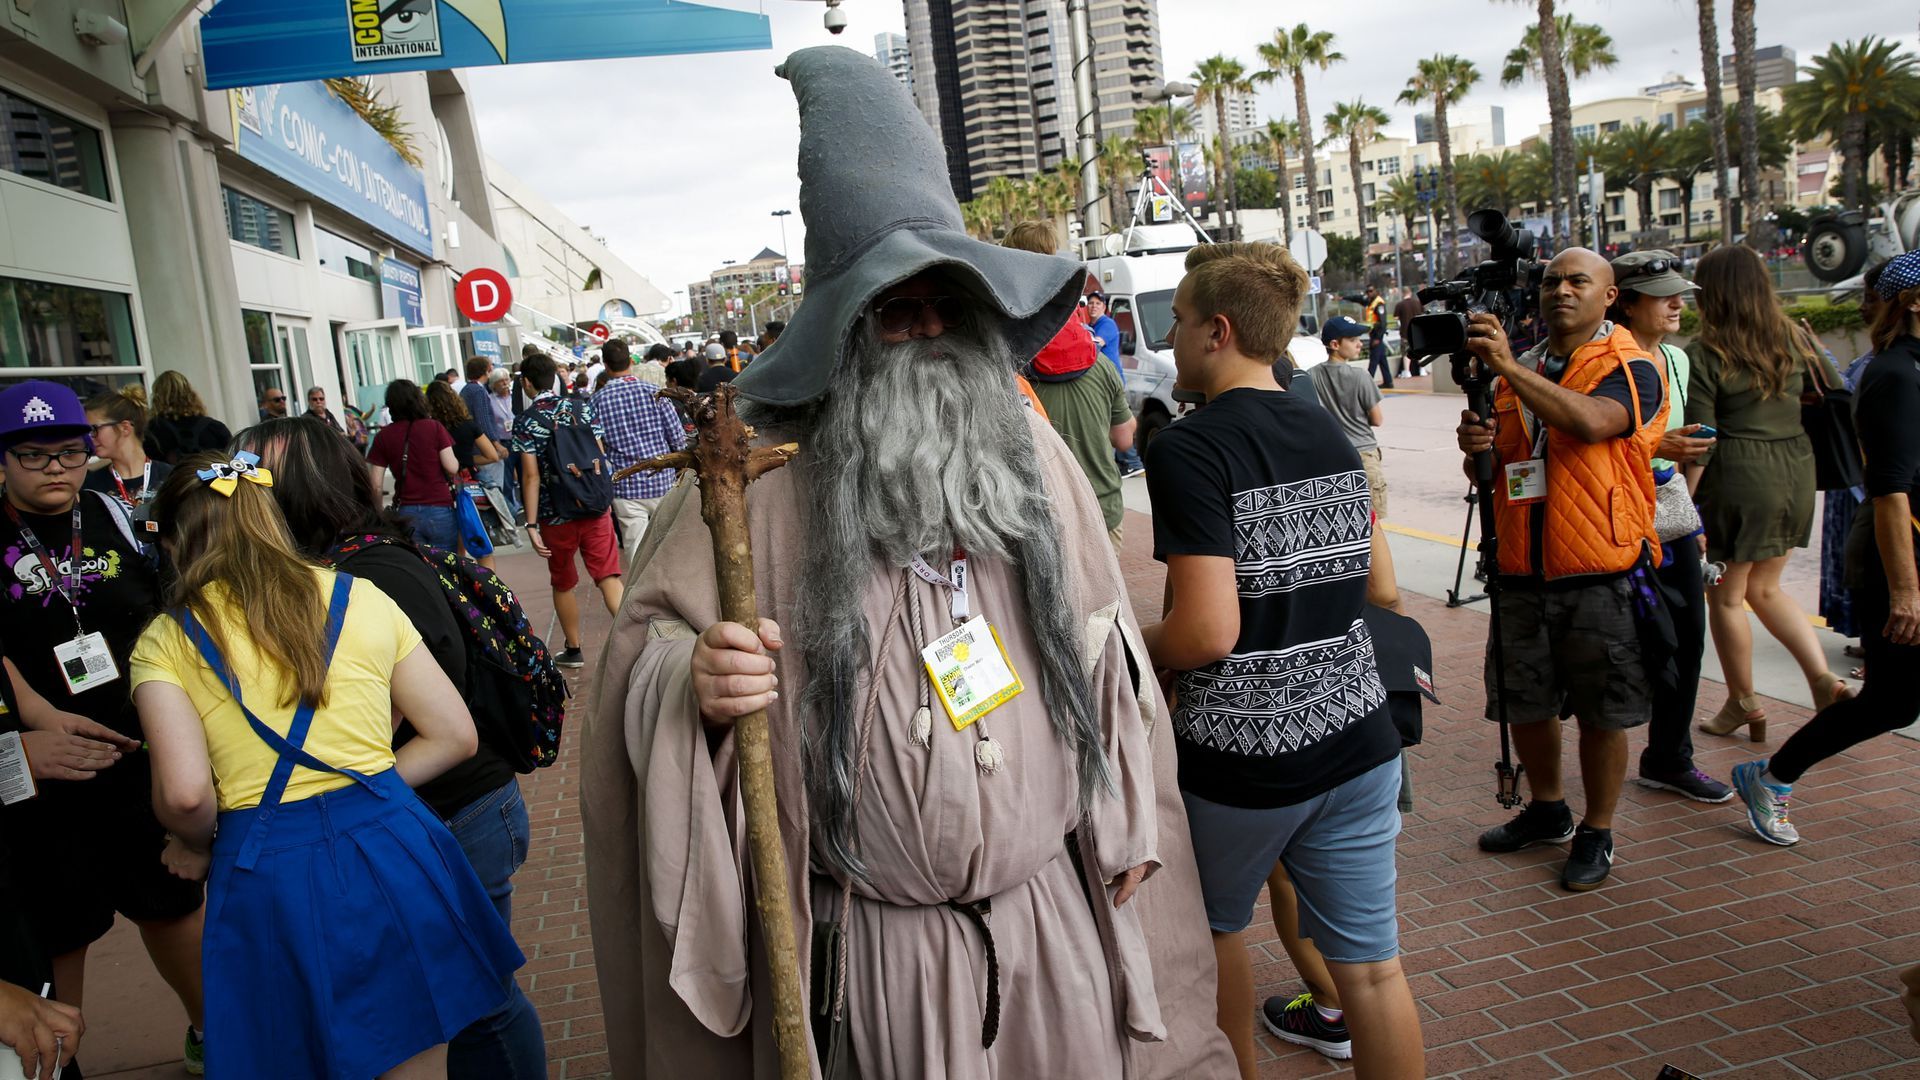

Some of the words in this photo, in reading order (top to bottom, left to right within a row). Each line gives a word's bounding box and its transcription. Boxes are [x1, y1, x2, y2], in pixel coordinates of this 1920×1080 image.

[355, 42, 438, 58] INTERNATIONAL
[280, 104, 363, 194] COMIC-CON
[361, 160, 430, 236] INTERNATIONAL
[470, 279, 500, 313] D
[938, 627, 966, 647] THURSDAY
